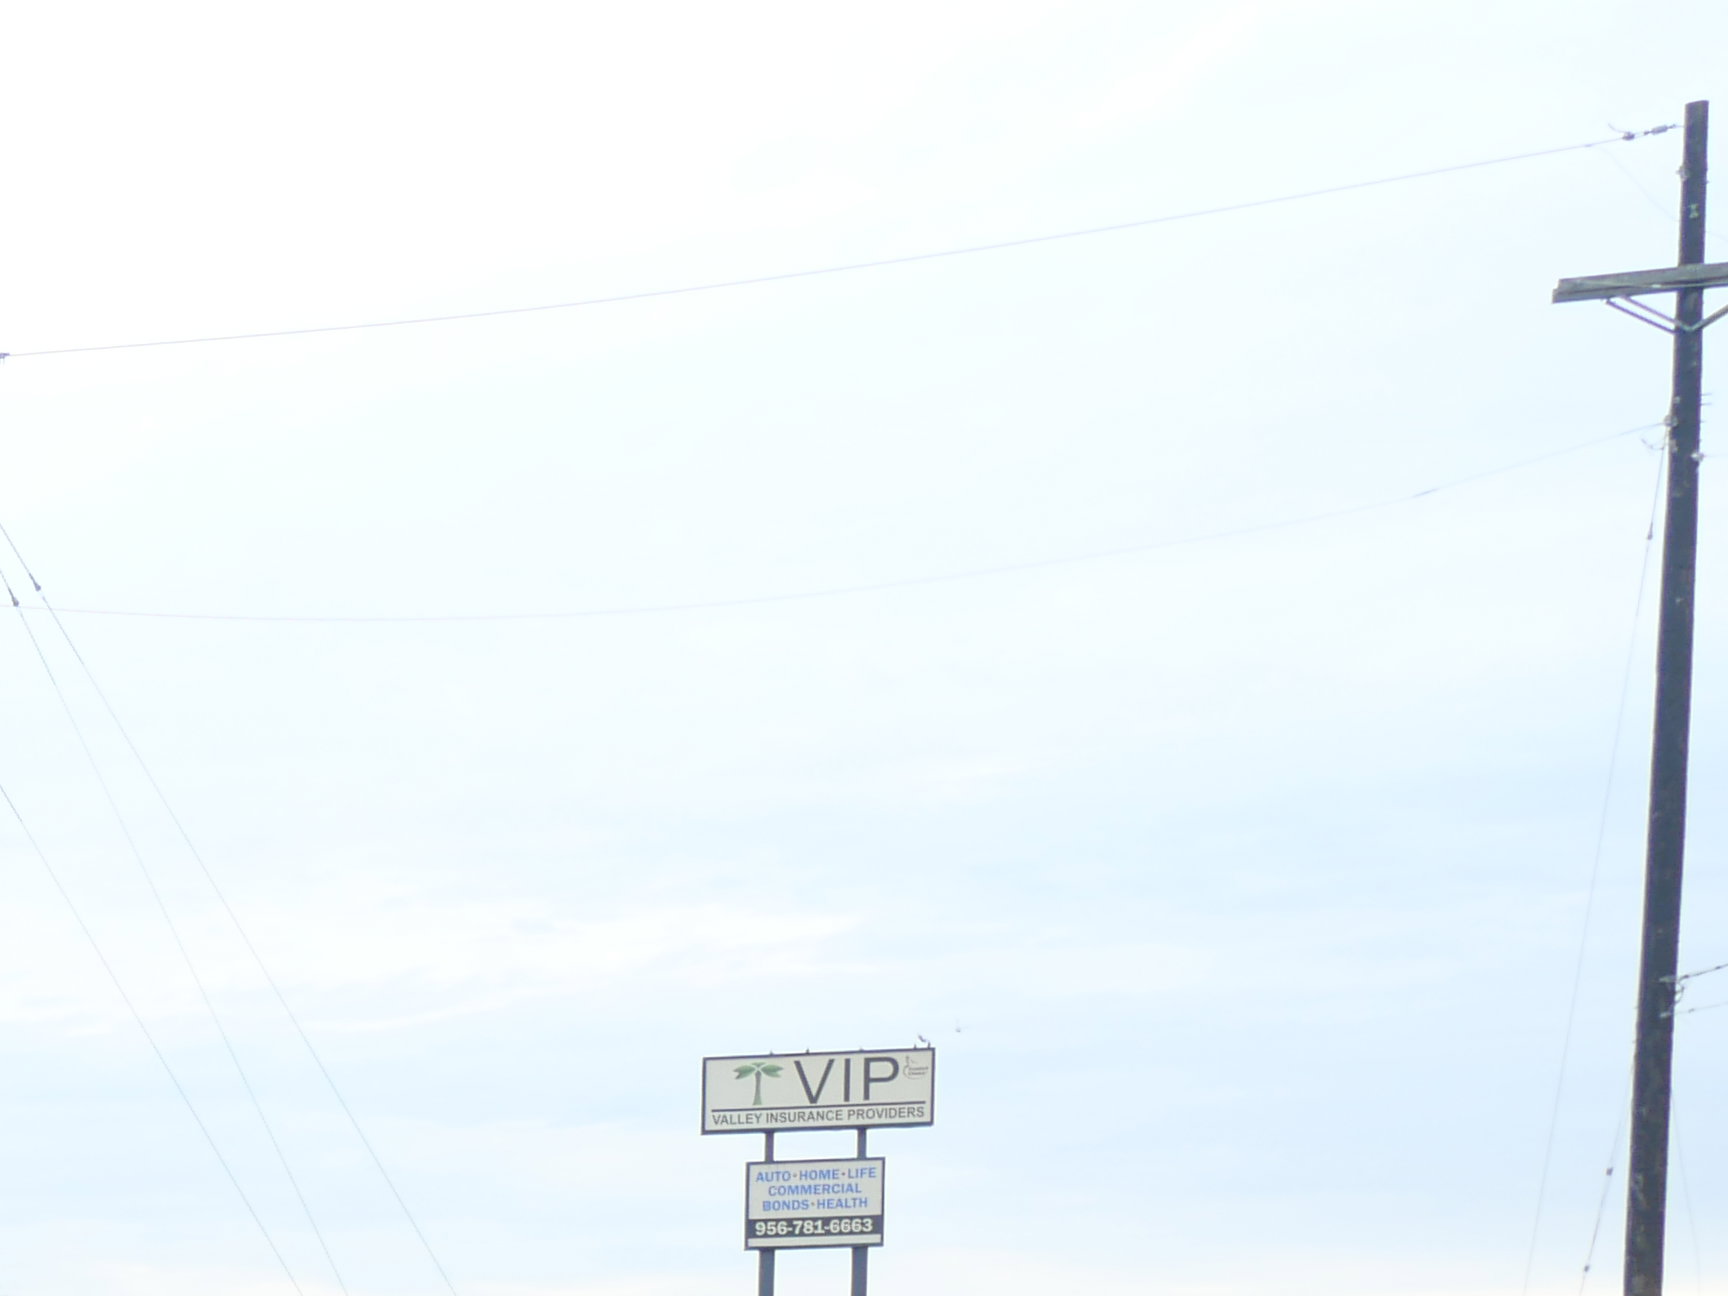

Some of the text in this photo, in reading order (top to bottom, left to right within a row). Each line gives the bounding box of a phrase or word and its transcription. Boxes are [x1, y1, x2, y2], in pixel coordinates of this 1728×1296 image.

[794, 1057, 899, 1105] VIP
[712, 1106, 925, 1125] VALLEY INSURANCE PROVIDERS
[756, 1166, 877, 1182] AUTO HOME LIFE
[768, 1183, 862, 1196] COMMERCIAL
[762, 1197, 869, 1212] BONDS HEALTH
[755, 1218, 873, 1236] 956-781-6663
